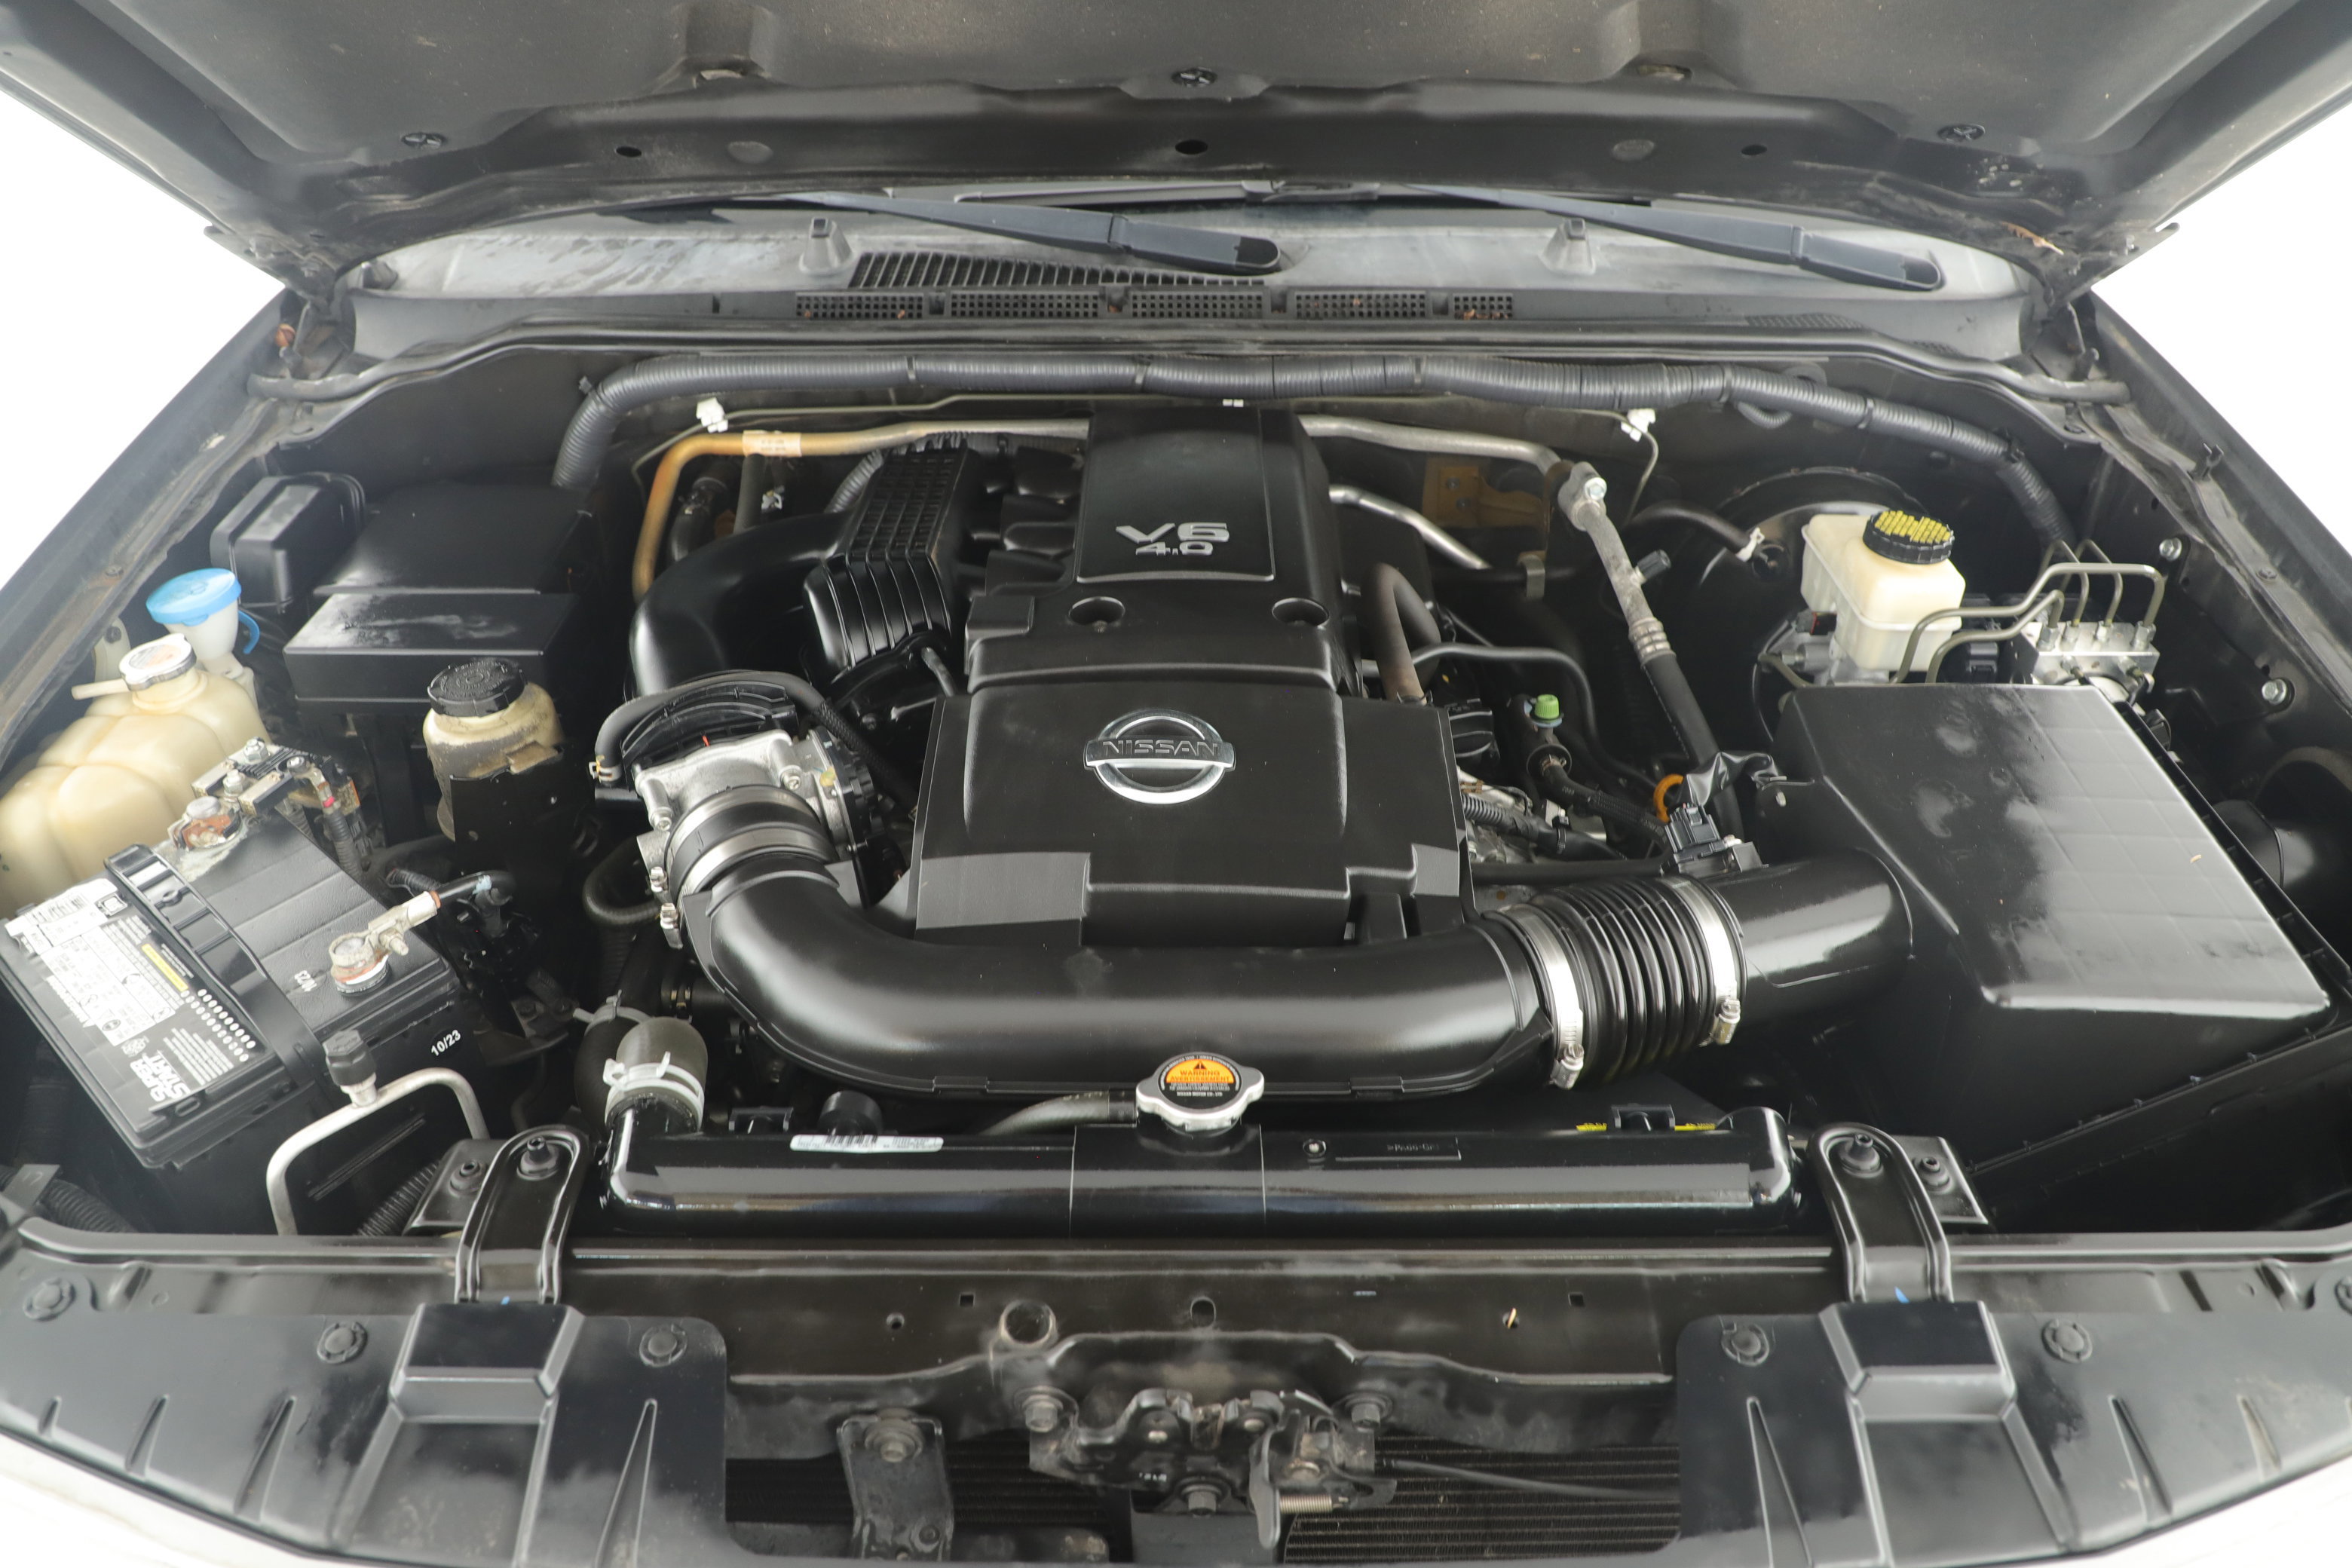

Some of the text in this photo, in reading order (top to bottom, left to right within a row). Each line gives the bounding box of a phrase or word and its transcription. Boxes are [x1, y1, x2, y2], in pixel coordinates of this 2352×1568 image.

[1115, 522, 1230, 544] V6
[1135, 541, 1214, 556] 4.0
[1101, 739, 1219, 758] NISSAN
[430, 1029, 461, 1056] 10/23
[130, 1058, 167, 1102] SUPER
[142, 1053, 191, 1100] START
